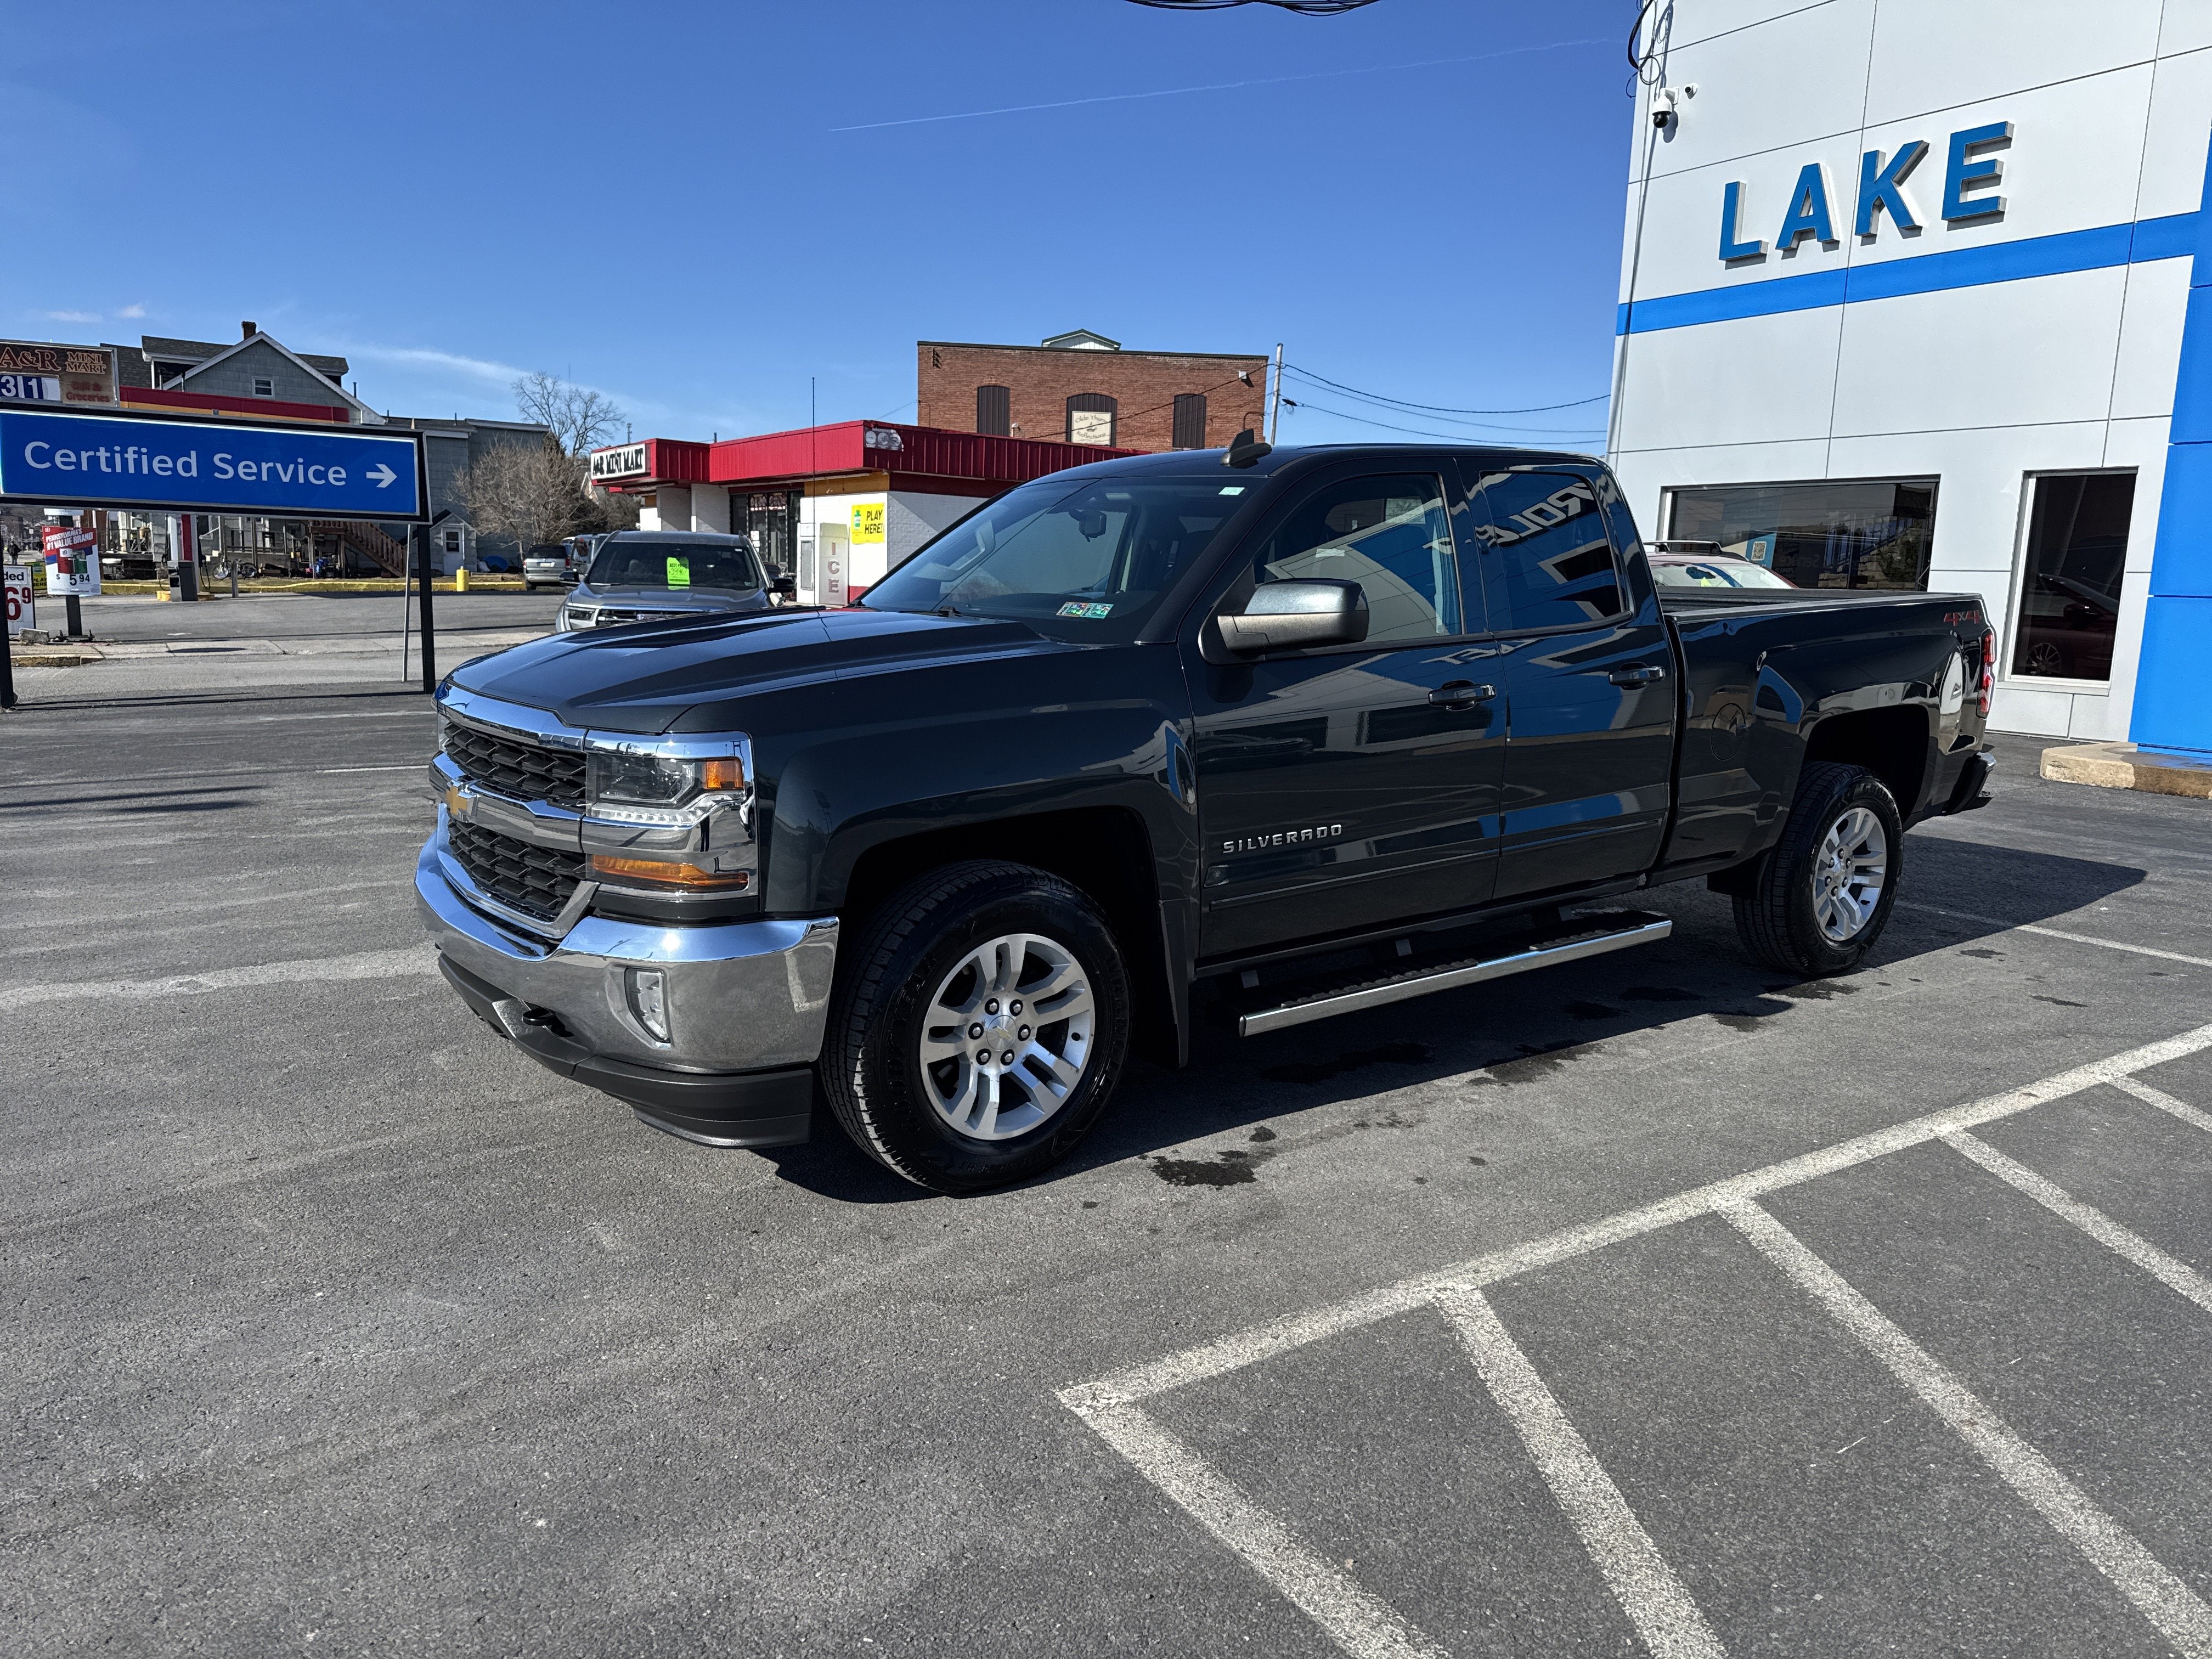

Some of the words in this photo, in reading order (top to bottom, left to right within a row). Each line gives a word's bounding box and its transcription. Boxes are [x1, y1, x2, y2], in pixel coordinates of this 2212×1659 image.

[1719, 121, 2015, 262] LAKE
[0, 346, 61, 371] A&R
[65, 362, 106, 374] MART
[66, 352, 103, 364] MINI
[66, 392, 110, 402] Groceries
[24, 441, 198, 477] Certified
[213, 453, 347, 486] Service
[623, 448, 644, 472] MART
[866, 510, 883, 521] PLAY
[46, 542, 54, 551] #1
[54, 538, 73, 549] VALUE
[73, 532, 93, 544] BRAND
[827, 542, 840, 592] ICE
[1222, 824, 1342, 854] SILVERADO
